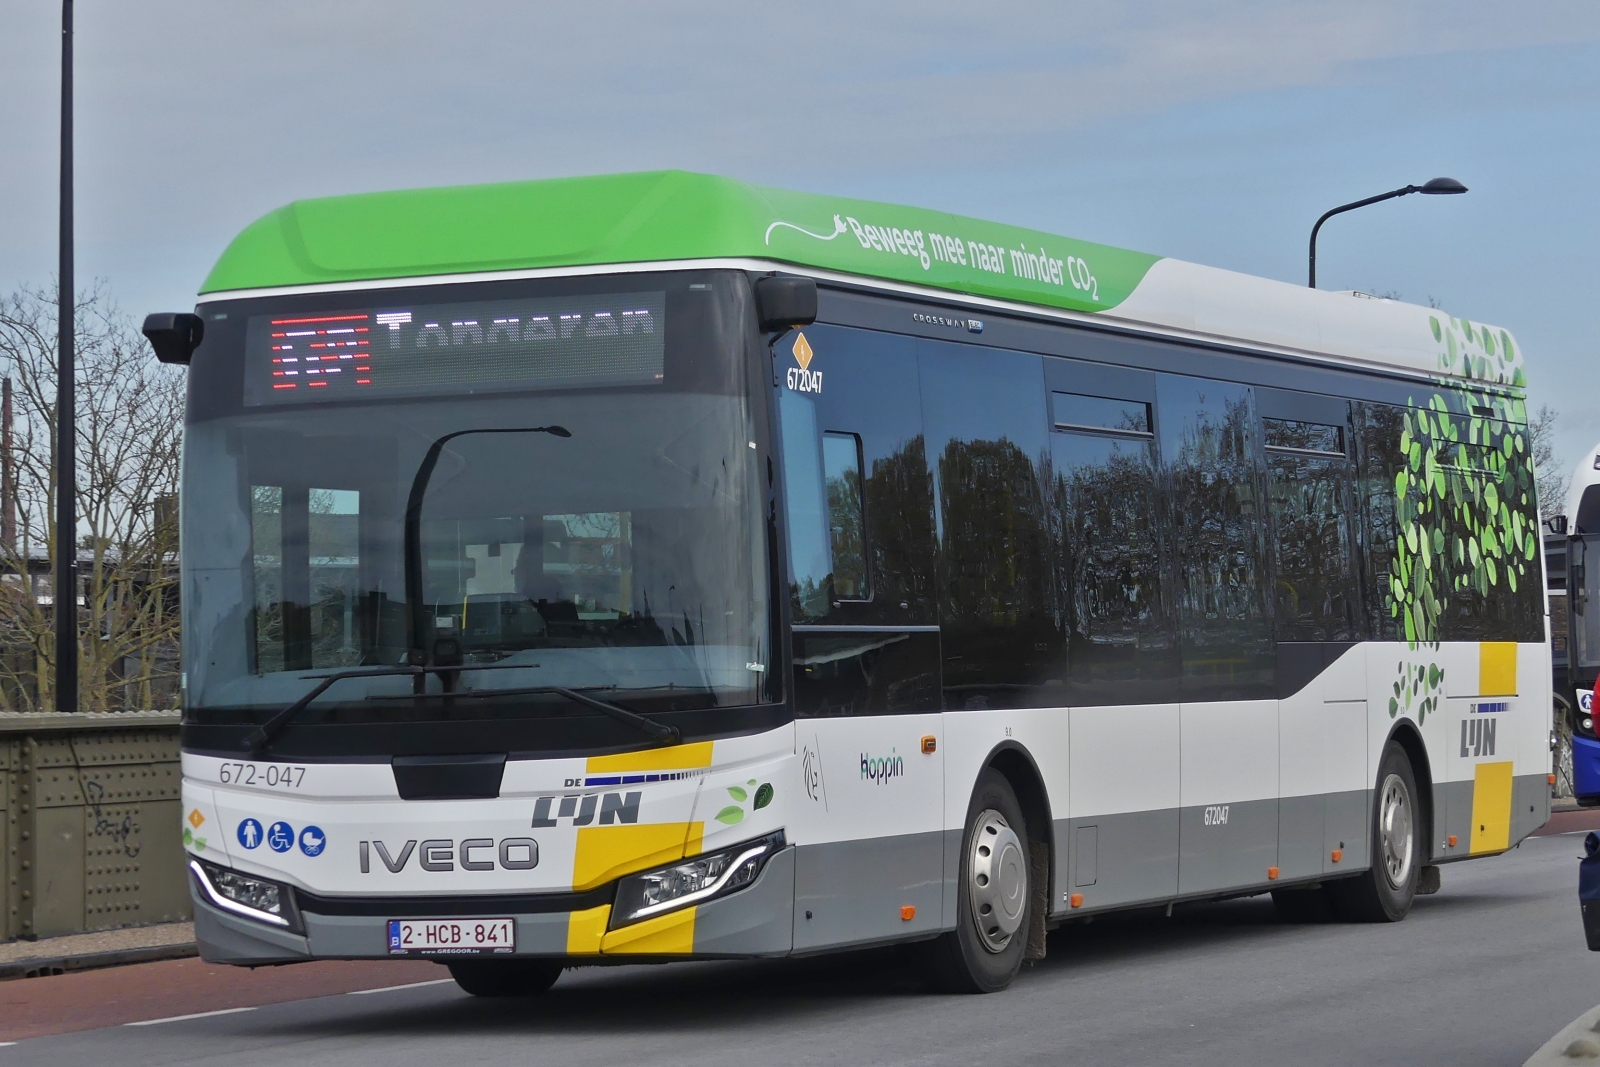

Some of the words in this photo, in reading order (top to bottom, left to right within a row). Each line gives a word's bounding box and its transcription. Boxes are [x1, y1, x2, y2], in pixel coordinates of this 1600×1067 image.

[846, 217, 931, 271] Beweeg
[928, 232, 967, 265] mee
[967, 240, 1005, 274] naar
[1010, 243, 1064, 286] minder
[913, 313, 965, 329] CROSSWAY
[787, 367, 823, 394] 672047
[1470, 703, 1477, 714] DE
[219, 762, 306, 788] 672-047
[860, 746, 904, 786] hoppin
[564, 778, 582, 788] DE
[1204, 805, 1230, 826] 672047
[359, 837, 539, 874] IVECO
[391, 936, 399, 946] B
